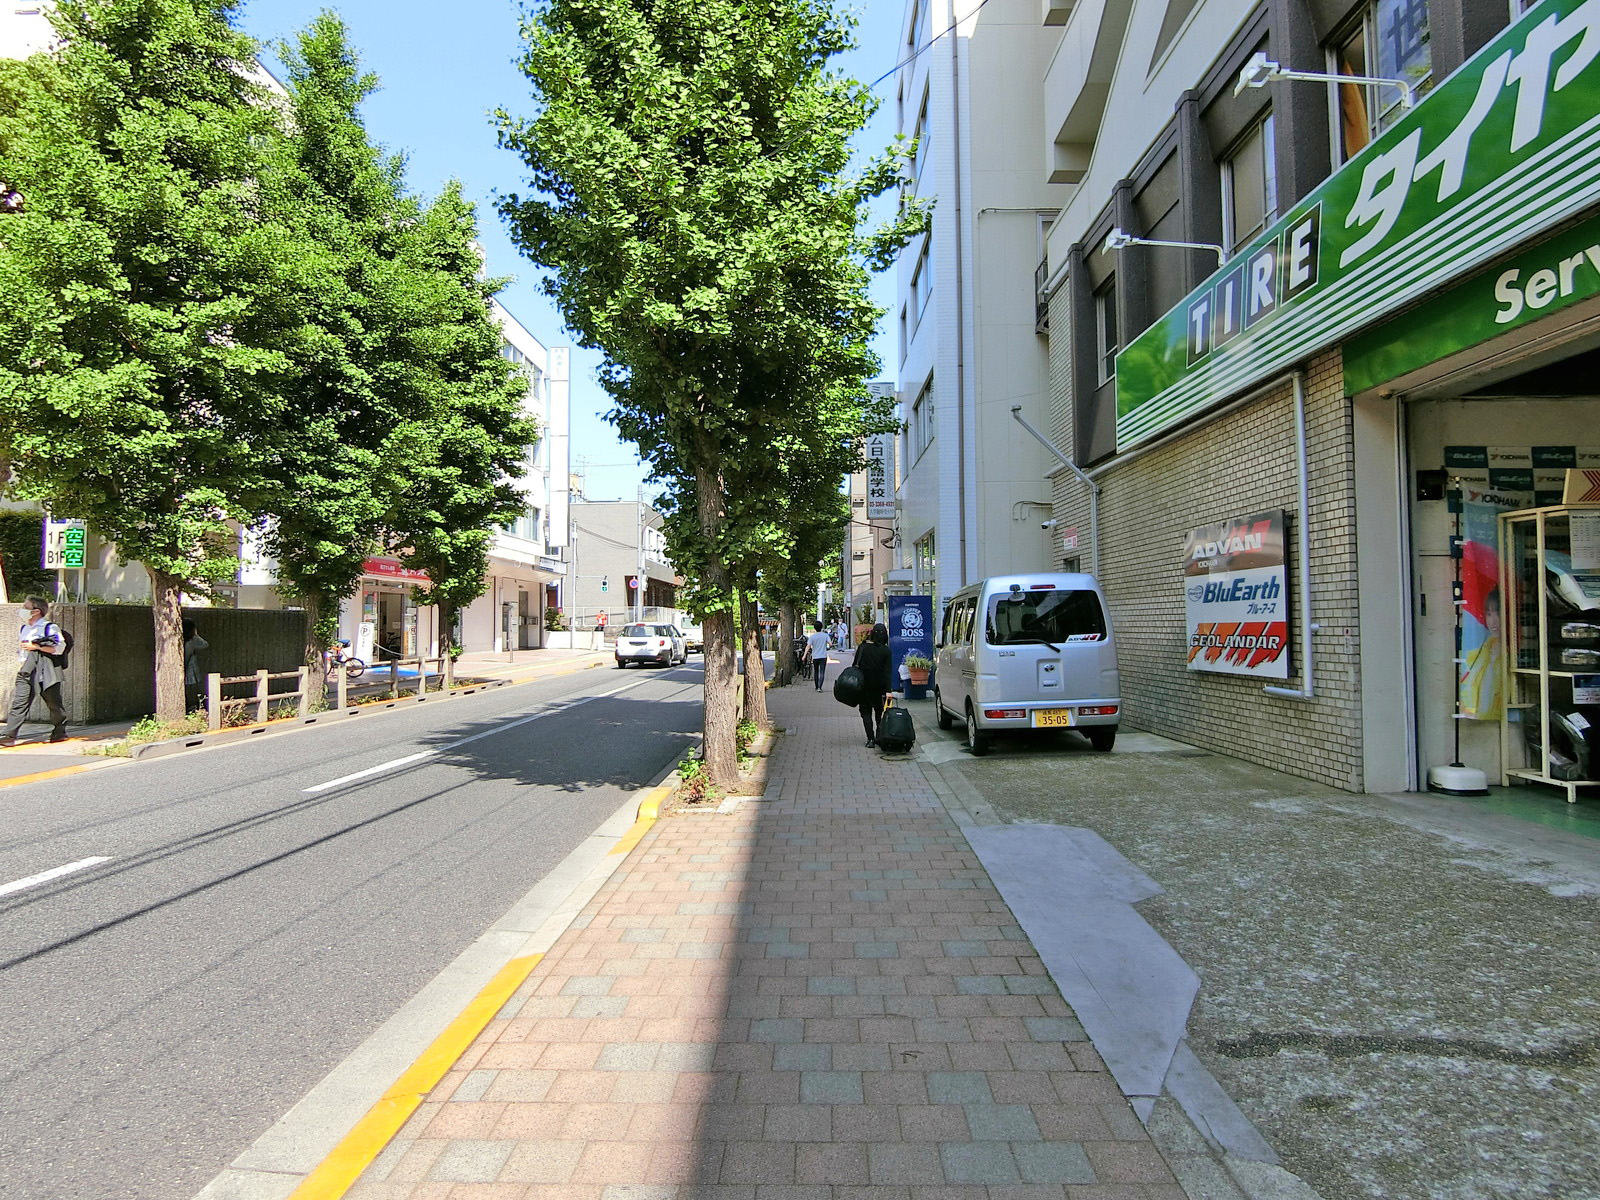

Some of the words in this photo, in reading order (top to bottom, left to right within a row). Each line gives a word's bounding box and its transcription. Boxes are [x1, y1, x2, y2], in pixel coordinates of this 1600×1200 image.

[1191, 217, 1313, 356] TIRE
[65, 528, 84, 547] 空
[1192, 532, 1261, 559] ADVAN
[47, 550, 65, 564] B1F
[65, 547, 84, 566] 空
[1203, 575, 1280, 604] BluEarth
[1247, 602, 1277, 615] ブルーアース
[900, 628, 924, 637] BOSS
[1189, 634, 1280, 650] GEOLANDAR
[1042, 715, 1067, 725] 35-05
